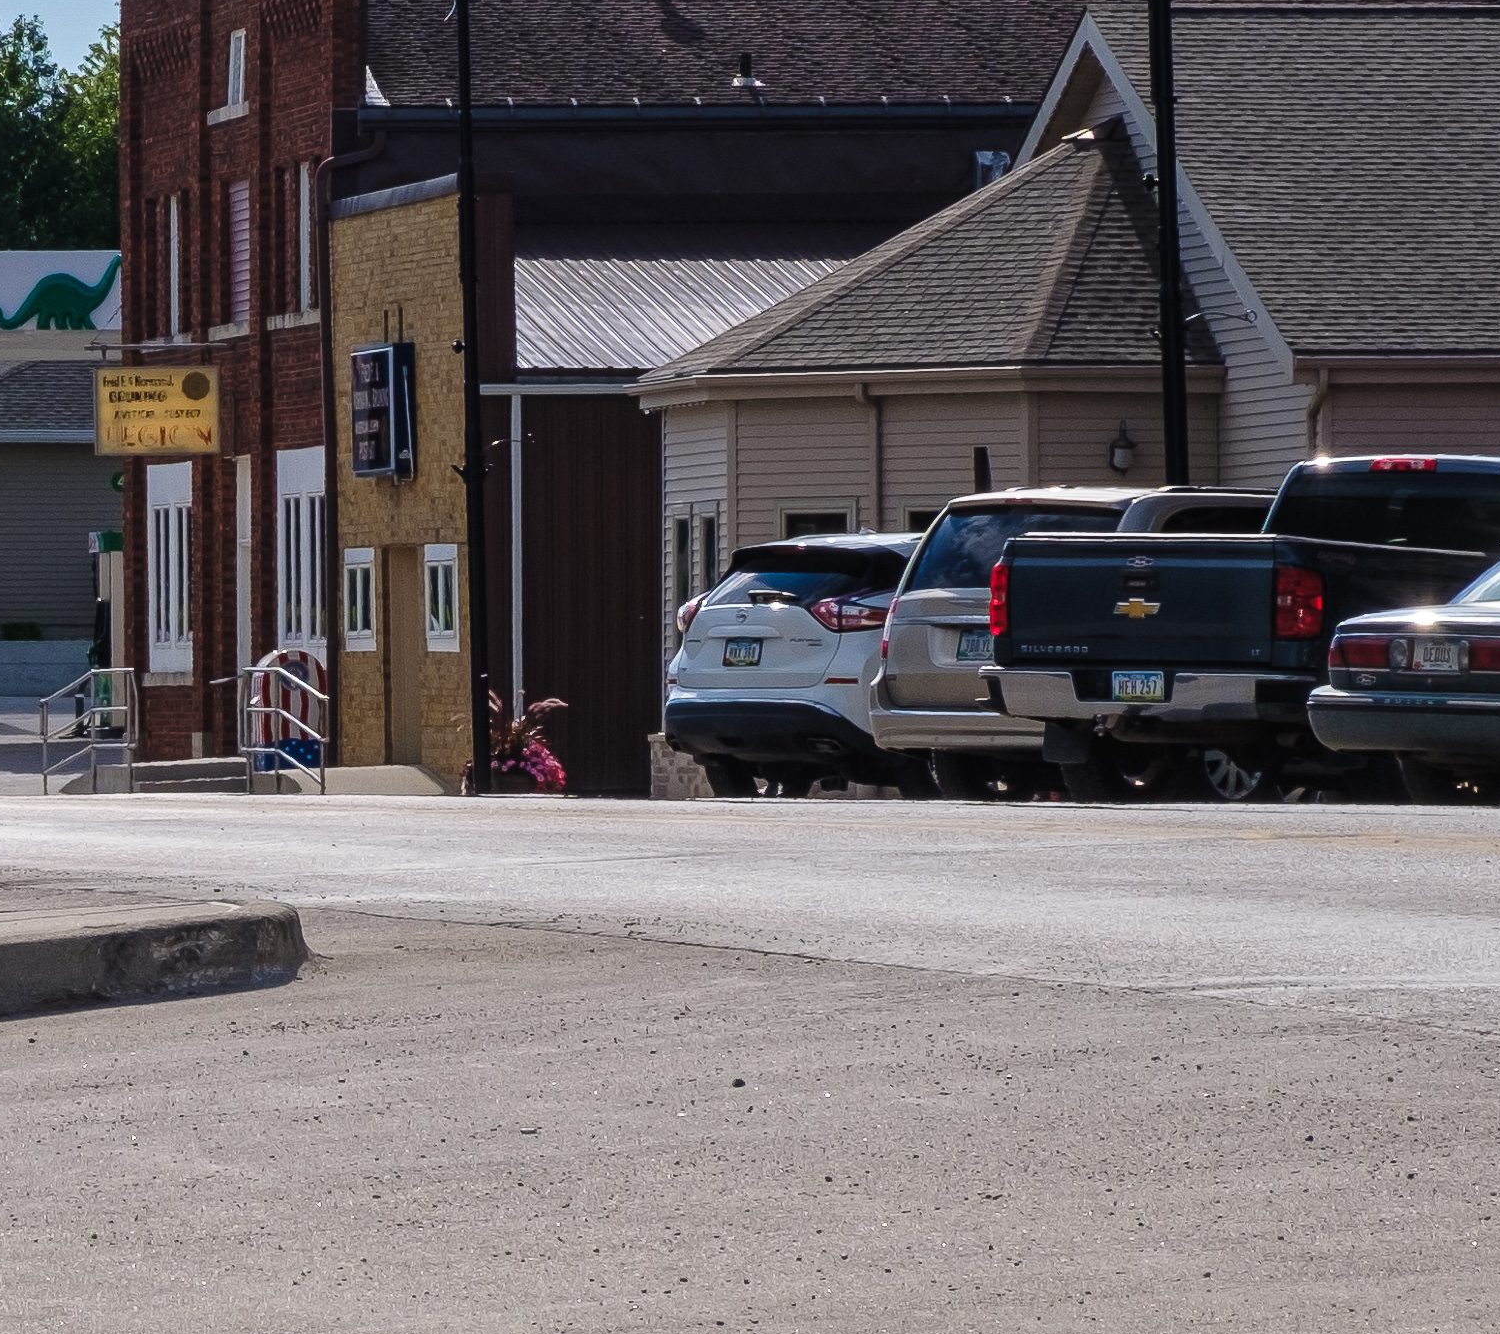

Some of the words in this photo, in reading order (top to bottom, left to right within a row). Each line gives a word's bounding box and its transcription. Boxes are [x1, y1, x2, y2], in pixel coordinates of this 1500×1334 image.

[1021, 645, 1089, 653] SILVERADO
[1119, 680, 1137, 695] HEH
[1140, 680, 1157, 695] 257
